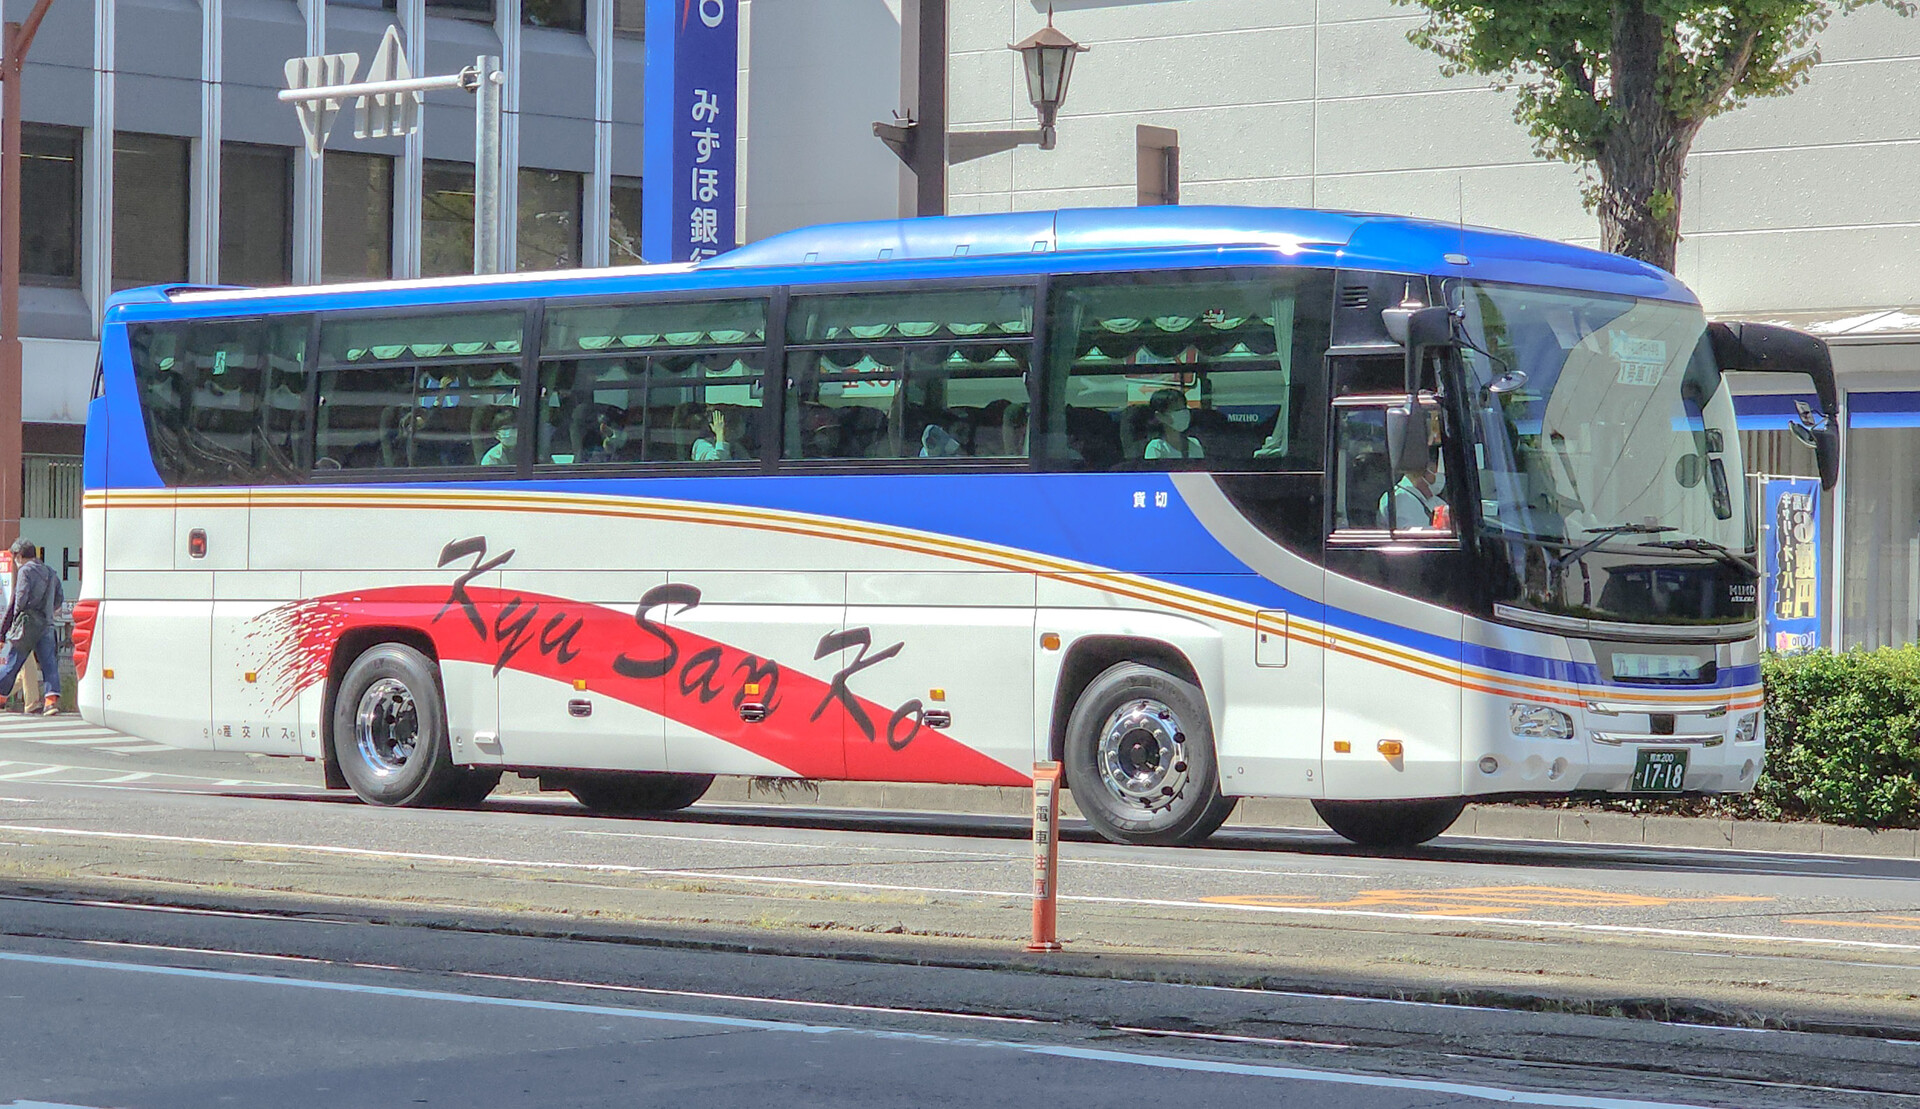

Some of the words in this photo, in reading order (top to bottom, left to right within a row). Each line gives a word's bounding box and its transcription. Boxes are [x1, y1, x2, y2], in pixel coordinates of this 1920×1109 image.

[1133, 491, 1168, 508] 貸切
[432, 535, 584, 679] Kyu
[613, 583, 782, 716] San
[810, 627, 925, 751] Ko
[223, 725, 289, 739] 産交バス
